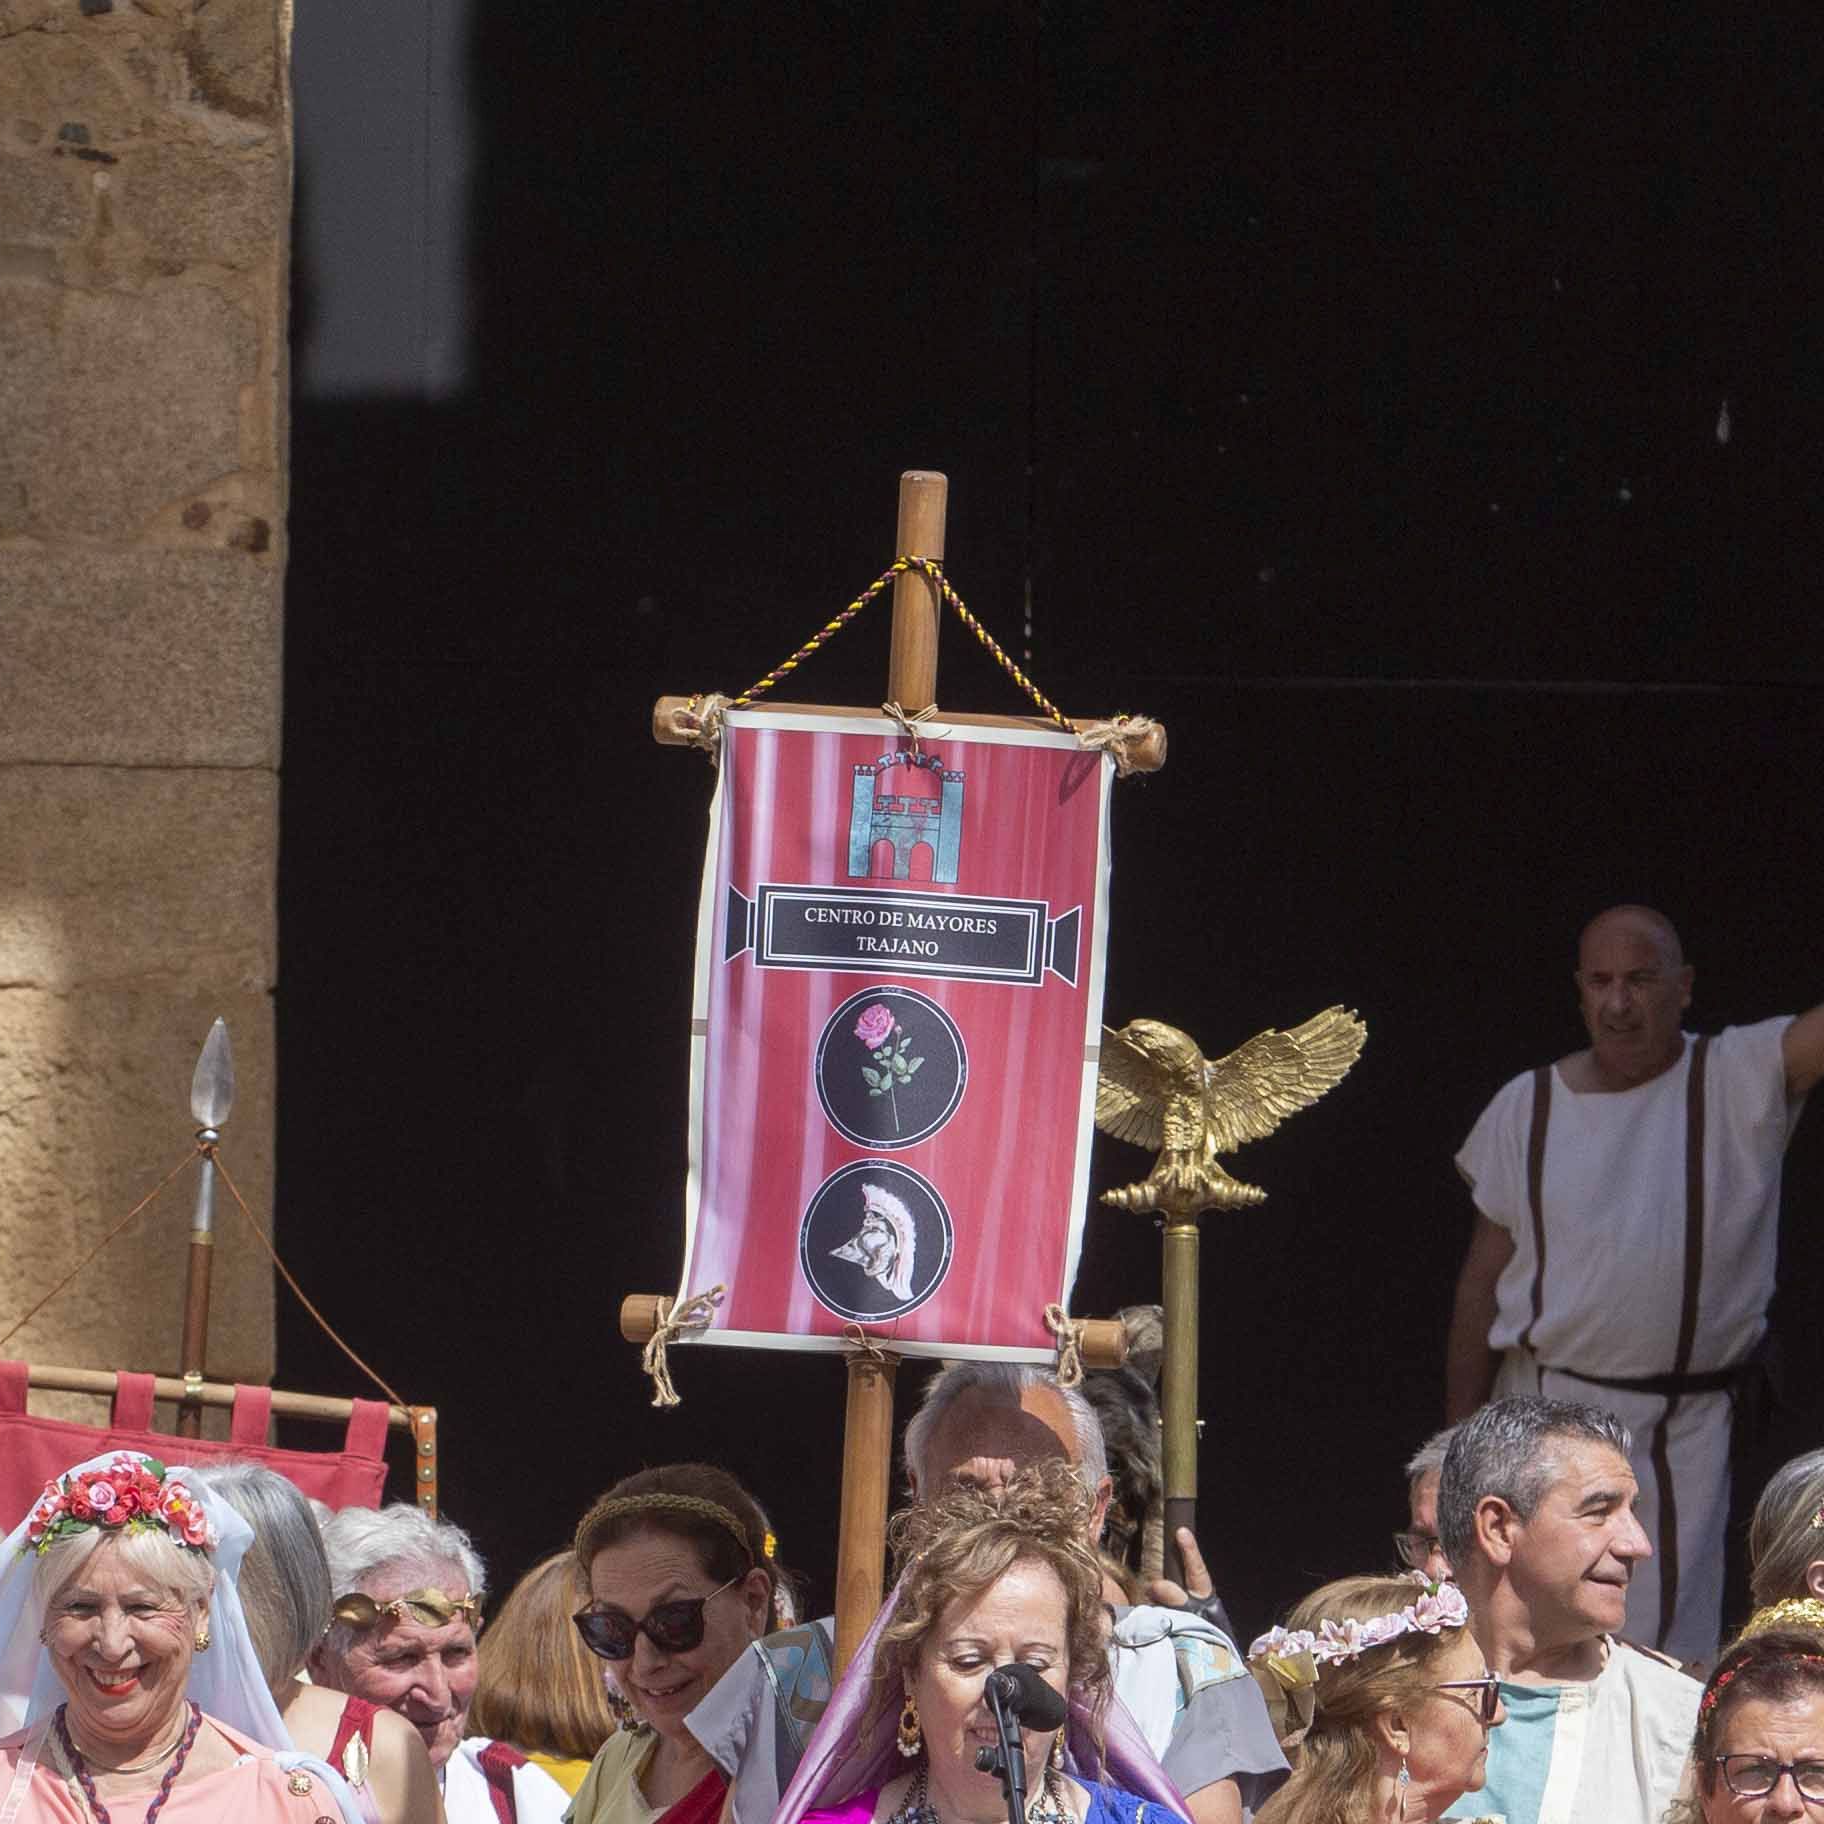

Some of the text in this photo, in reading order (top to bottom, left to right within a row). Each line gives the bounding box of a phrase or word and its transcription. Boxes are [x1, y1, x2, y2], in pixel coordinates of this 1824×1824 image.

[804, 906, 998, 935] CENTRO DE MAYORES
[856, 936, 939, 957] TRAJANO
